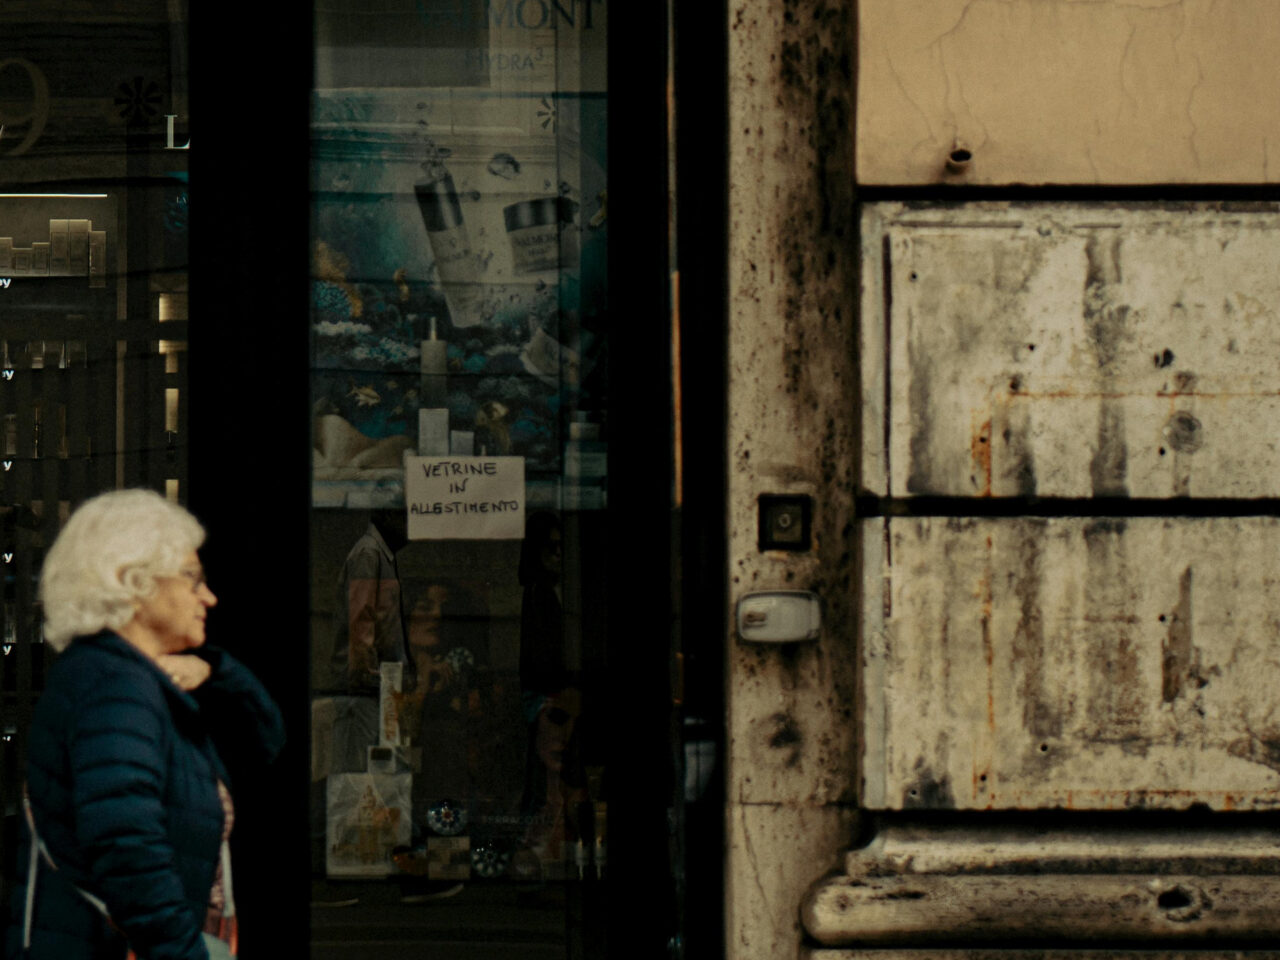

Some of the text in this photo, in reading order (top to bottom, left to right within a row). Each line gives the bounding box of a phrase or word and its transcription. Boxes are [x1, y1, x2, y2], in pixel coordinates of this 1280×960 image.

[422, 461, 498, 478] VETRINE
[449, 477, 470, 494] IN
[410, 499, 520, 515] ALLESTIMENTO
